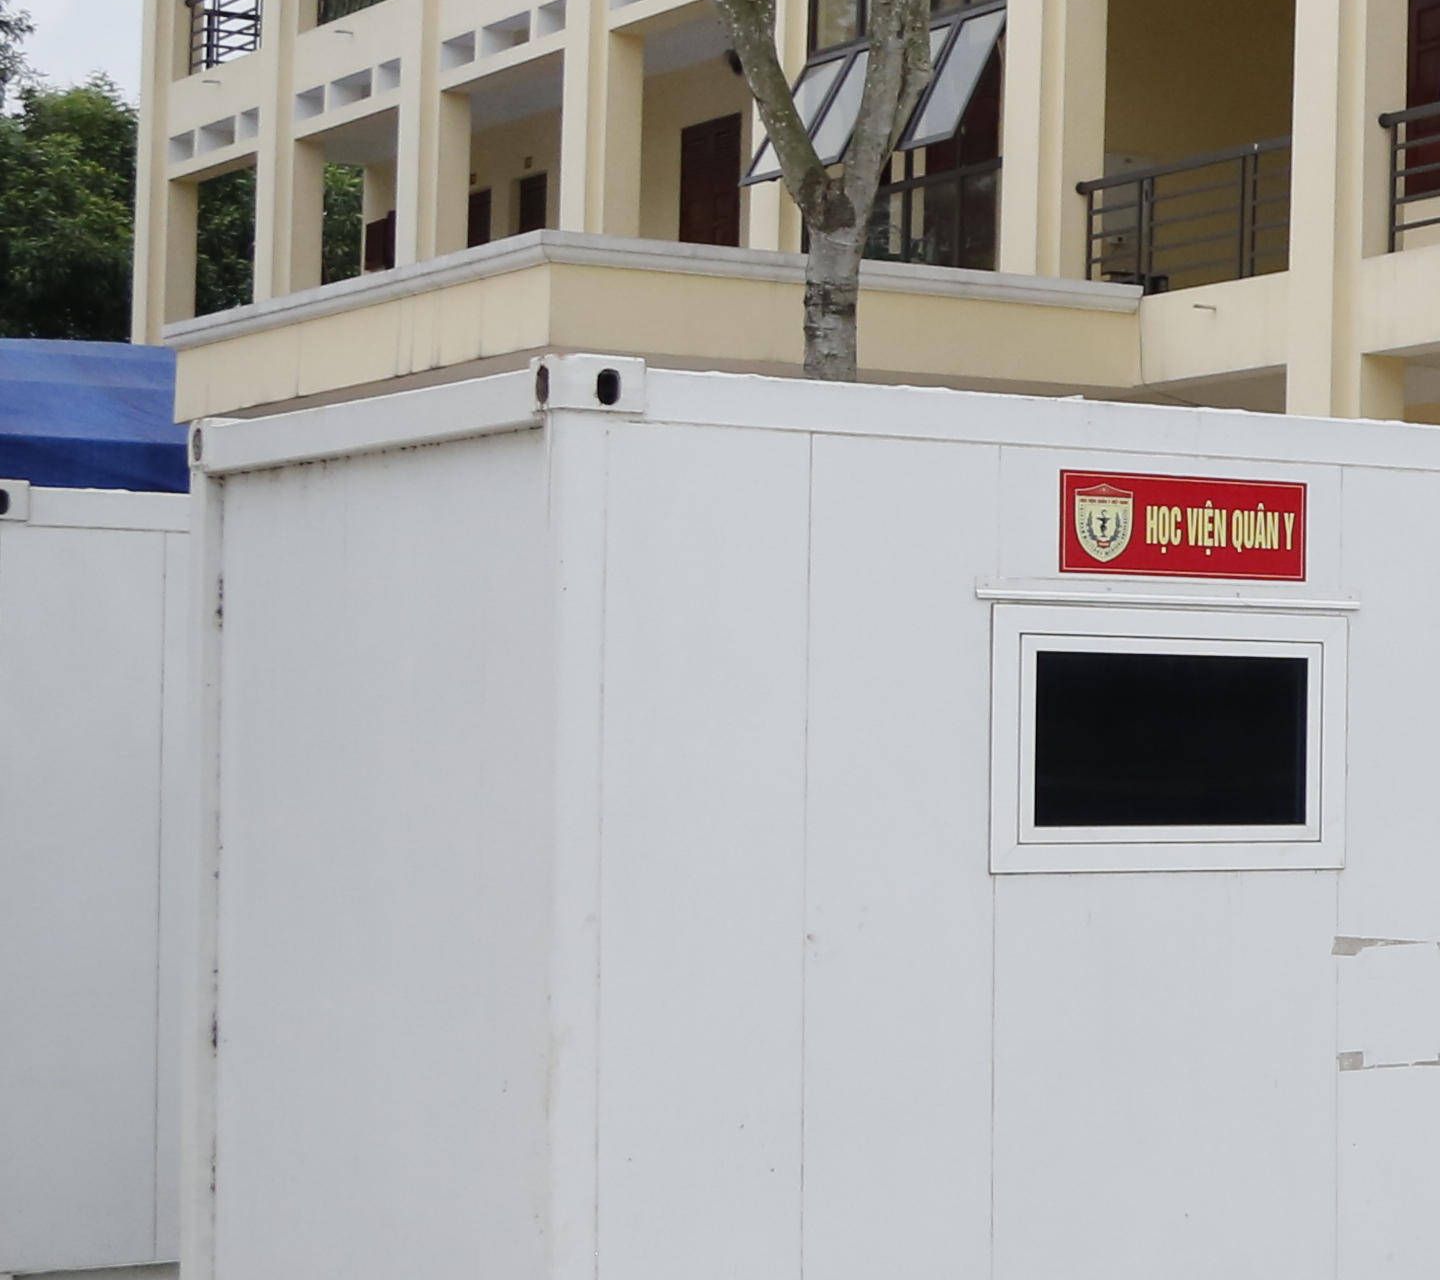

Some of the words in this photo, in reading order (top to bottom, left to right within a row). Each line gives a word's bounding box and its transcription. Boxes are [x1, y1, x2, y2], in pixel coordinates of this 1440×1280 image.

[1146, 505, 1182, 554] HỌC
[1186, 499, 1227, 556] VIỆN
[1231, 502, 1279, 552] QUÂN
[1283, 512, 1295, 550] Y
